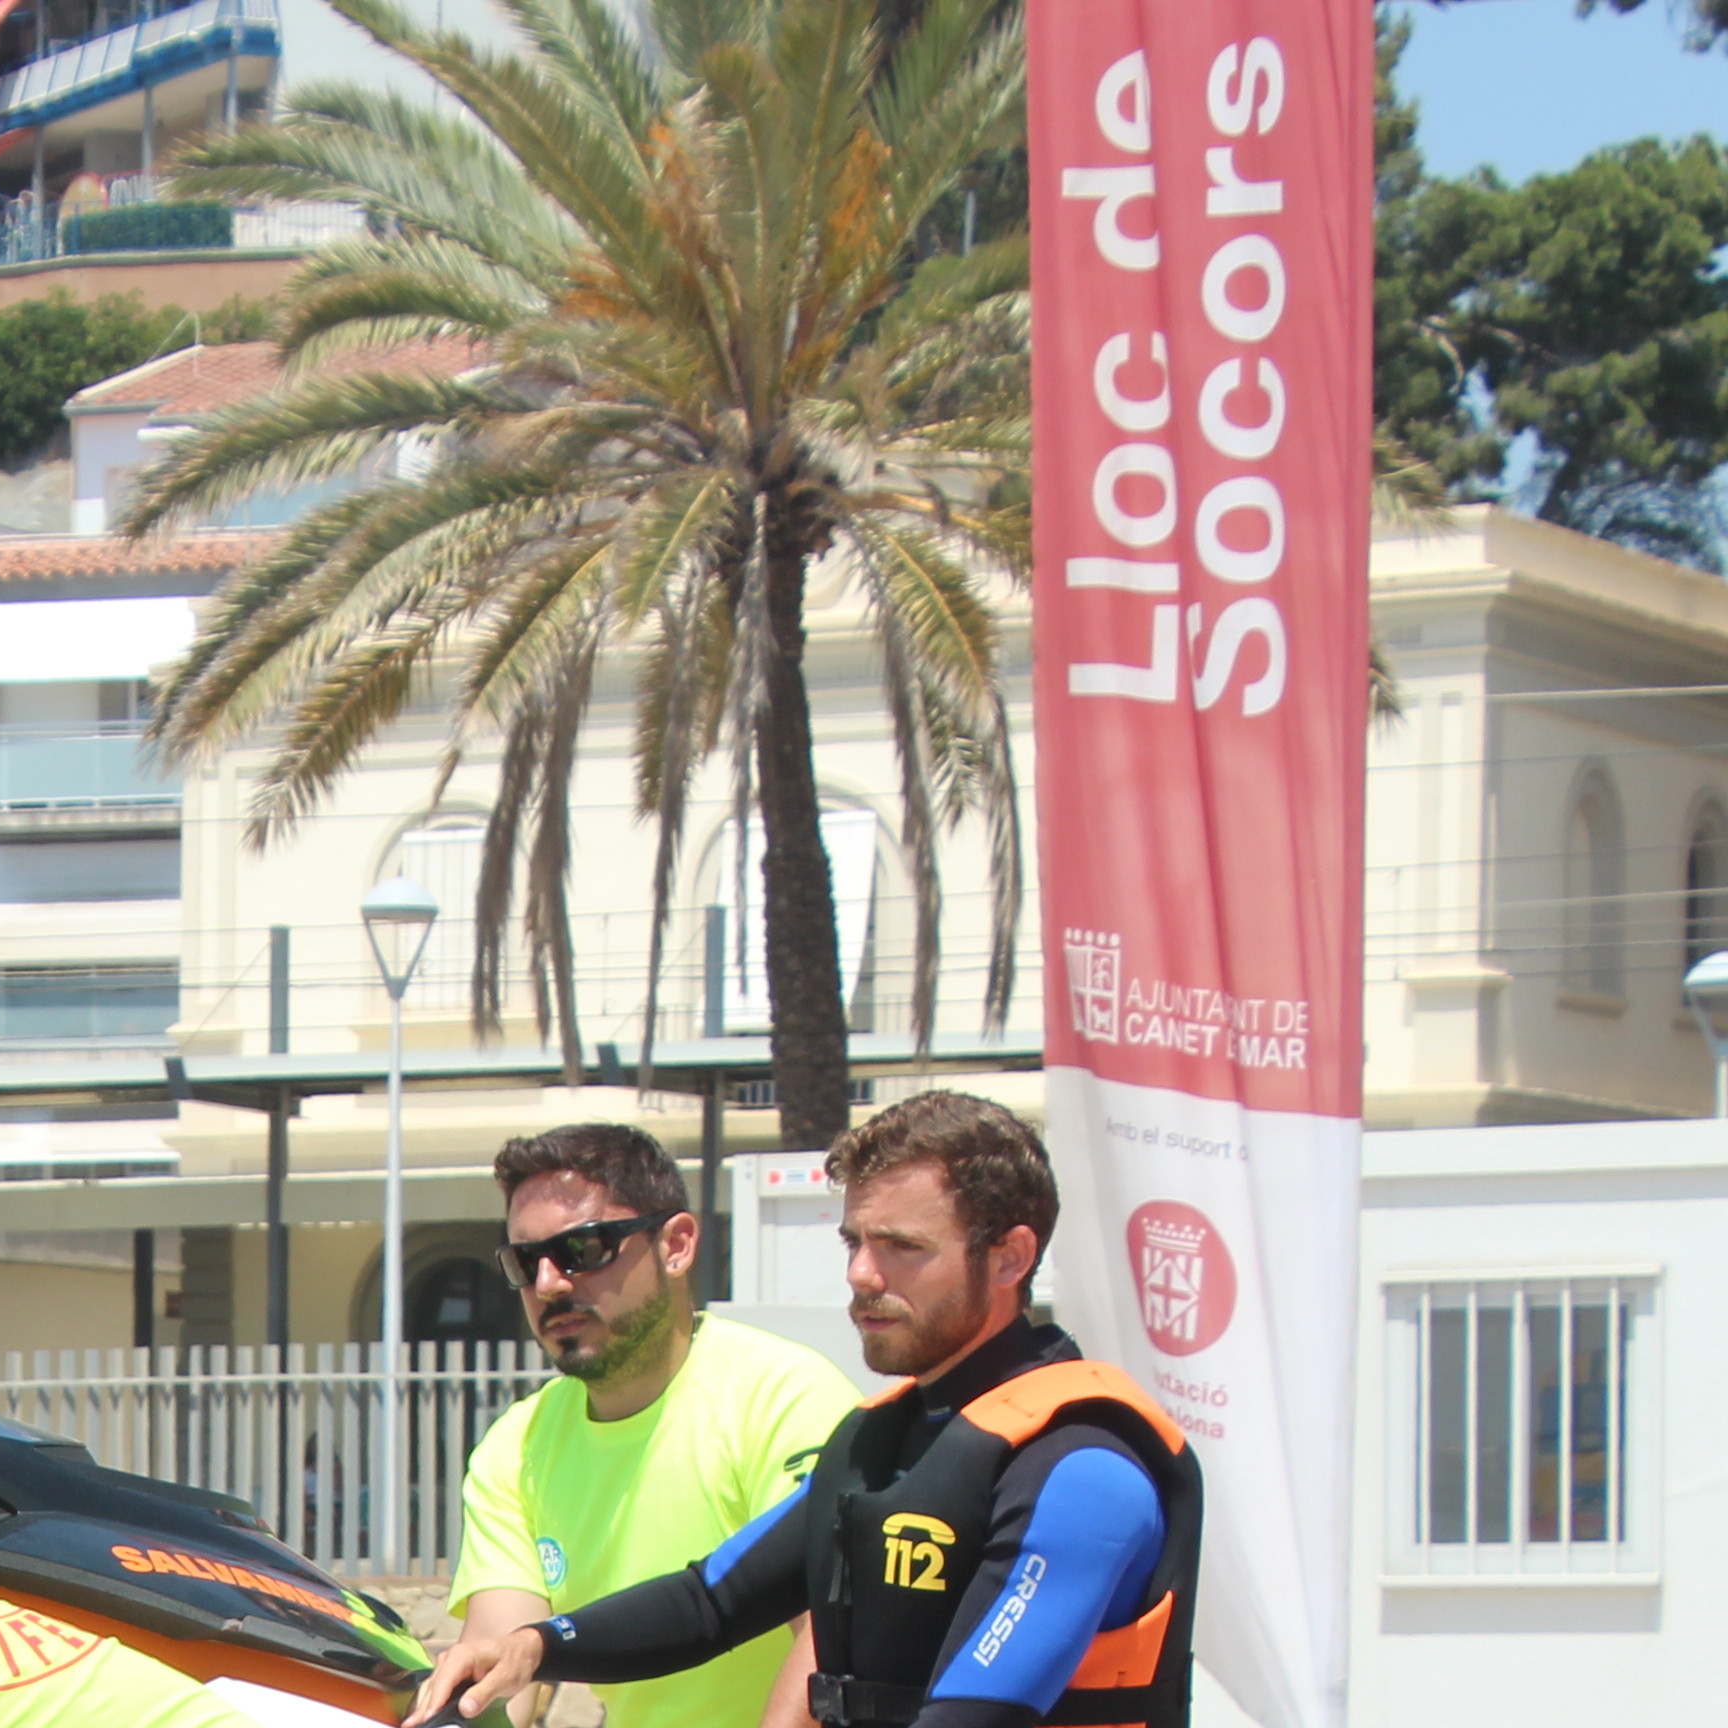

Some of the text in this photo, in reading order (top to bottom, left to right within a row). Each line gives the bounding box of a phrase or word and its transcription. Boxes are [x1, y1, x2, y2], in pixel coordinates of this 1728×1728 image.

[1061, 48, 1161, 272] de
[1185, 36, 1287, 718] Socors
[1125, 1012, 1221, 1057] CANET
[1238, 1034, 1307, 1069] MAR
[1273, 1000, 1309, 1034] DE
[1166, 1131, 1232, 1159] suport
[883, 1536, 947, 1592] 112
[972, 1553, 1048, 1668] CRESSI
